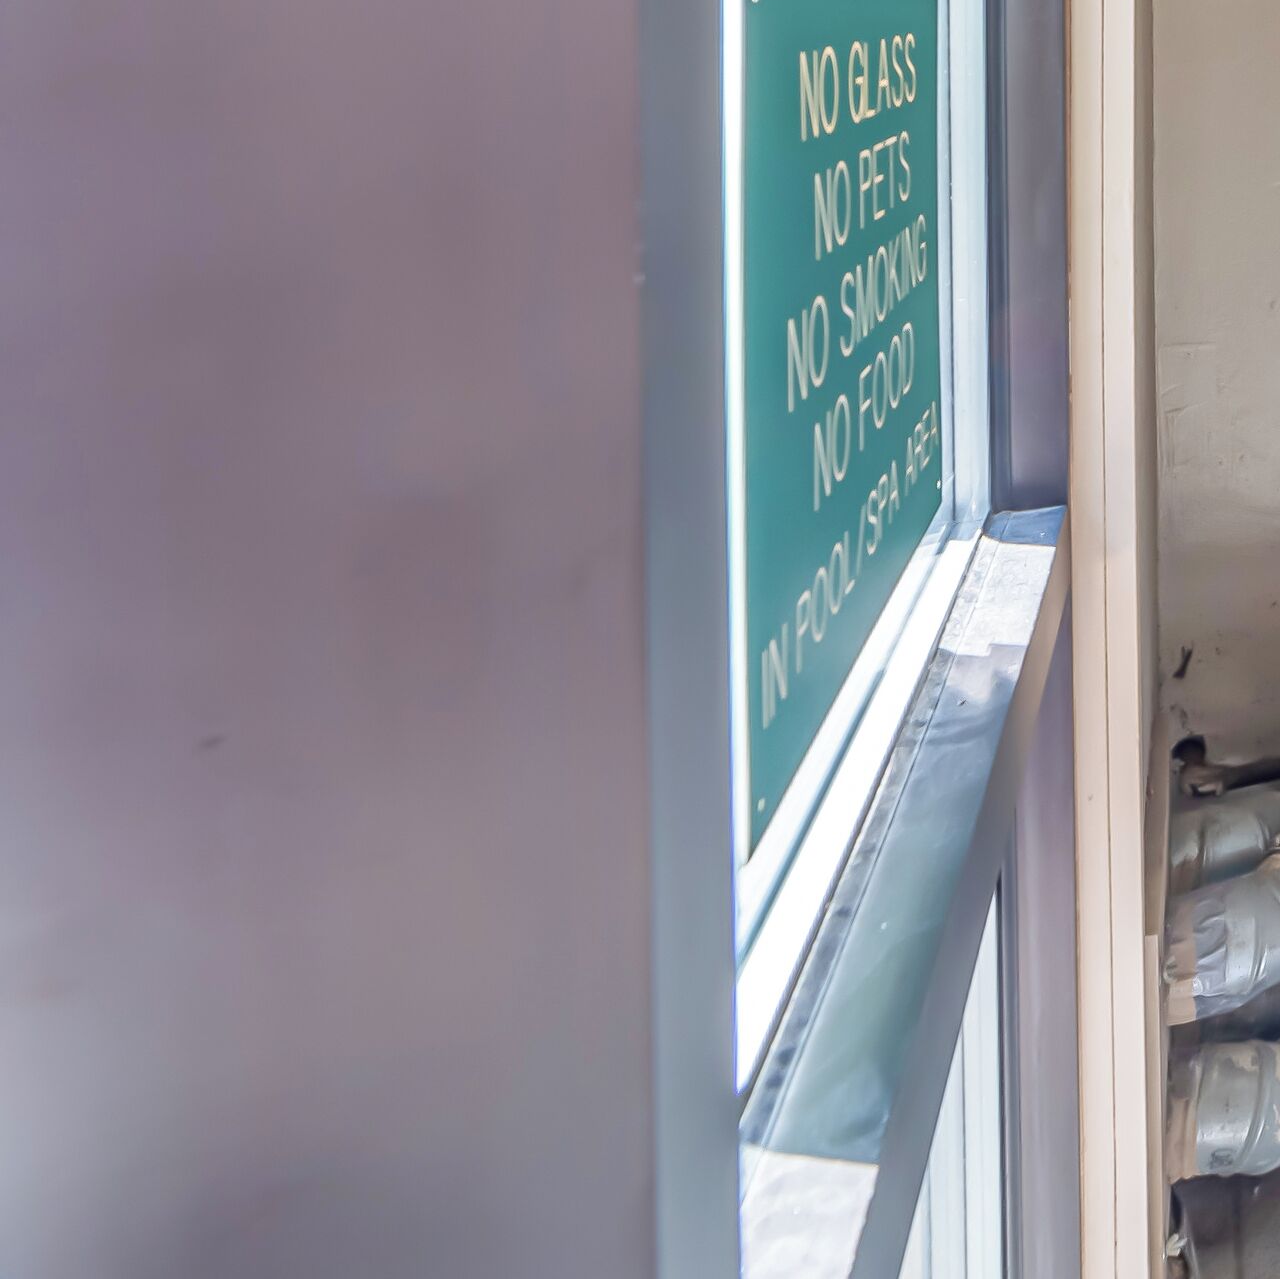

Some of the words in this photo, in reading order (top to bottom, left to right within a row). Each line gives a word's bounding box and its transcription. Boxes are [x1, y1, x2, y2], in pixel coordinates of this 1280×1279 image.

[800, 45, 840, 143] NO
[847, 32, 917, 125] GLASS
[814, 160, 851, 262] NO
[859, 130, 911, 230] PETS
[787, 295, 831, 413] NO
[840, 214, 927, 357] SMOKING
[813, 393, 851, 513] NO
[859, 322, 915, 452] FOOD
[761, 622, 789, 730] IN
[905, 400, 940, 497] AREA
